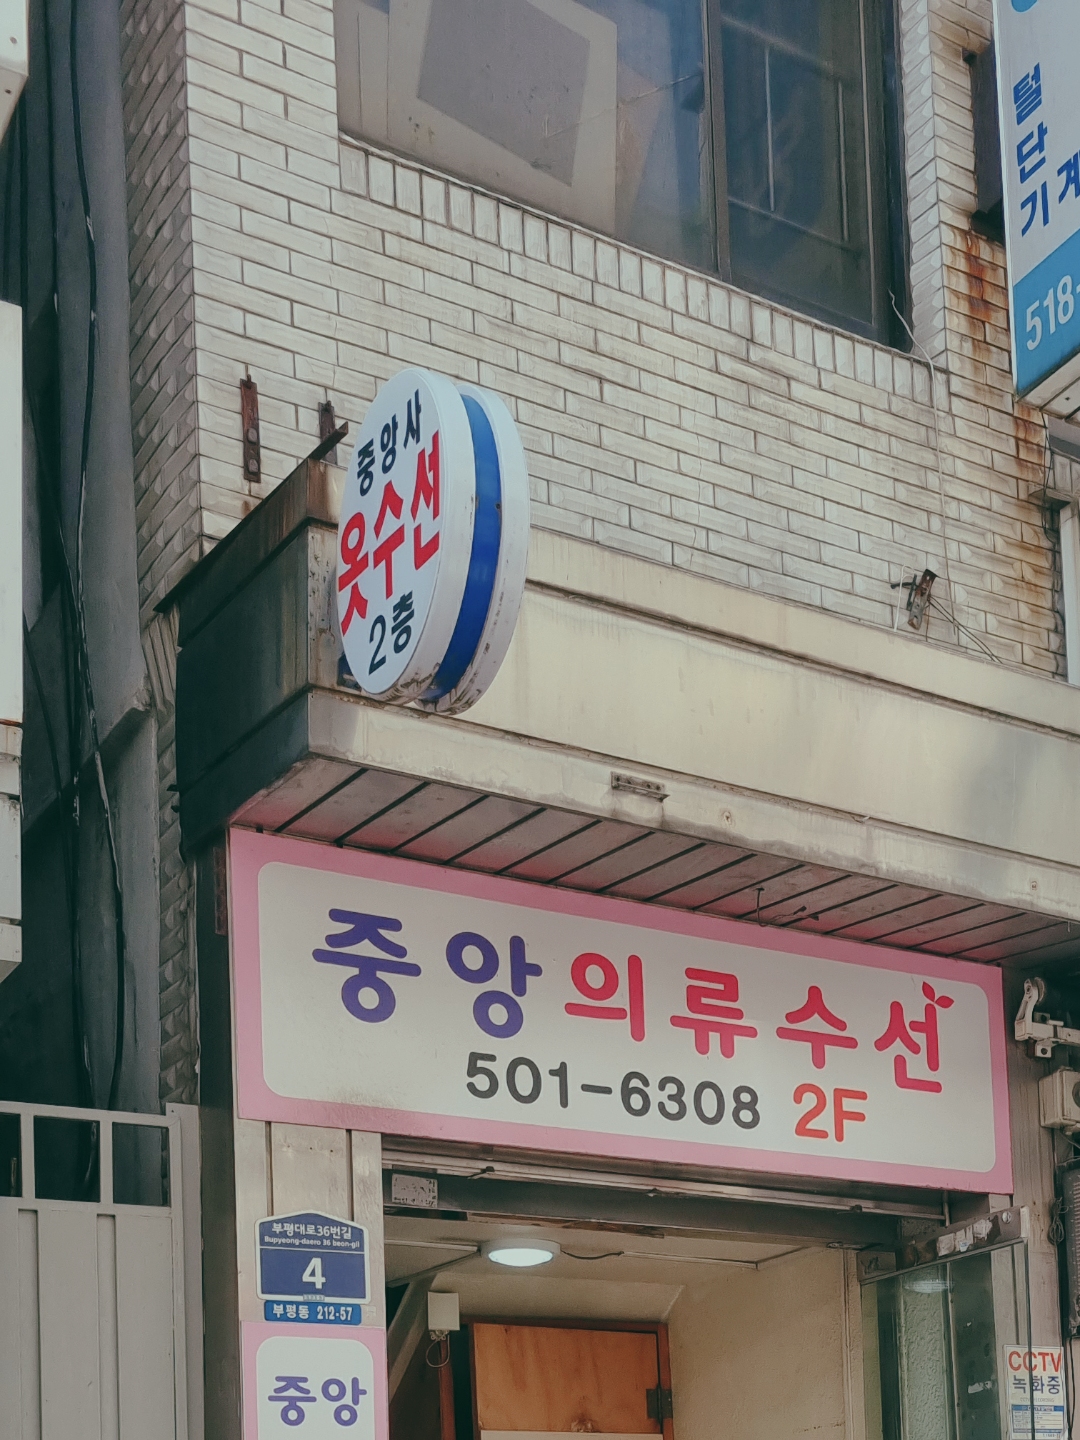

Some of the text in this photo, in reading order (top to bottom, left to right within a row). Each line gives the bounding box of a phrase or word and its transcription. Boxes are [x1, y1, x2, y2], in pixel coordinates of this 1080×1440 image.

[357, 389, 422, 497] 중앙사
[338, 430, 440, 637] 옷수선
[368, 591, 415, 676] 2층
[312, 908, 952, 1094] 중앙의류수선
[466, 1051, 868, 1142] 501-6308 2F
[264, 1235, 322, 1246] Bupyeong-daero
[322, 1238, 331, 1247] 36
[271, 1222, 351, 1240] 부평대로36번길
[301, 1257, 326, 1290] 4
[272, 1304, 353, 1321] 부평동 212-57
[1008, 1350, 1063, 1373] CCTV
[267, 1376, 367, 1426] 중앙
[1012, 1375, 1061, 1395] 녹화중
